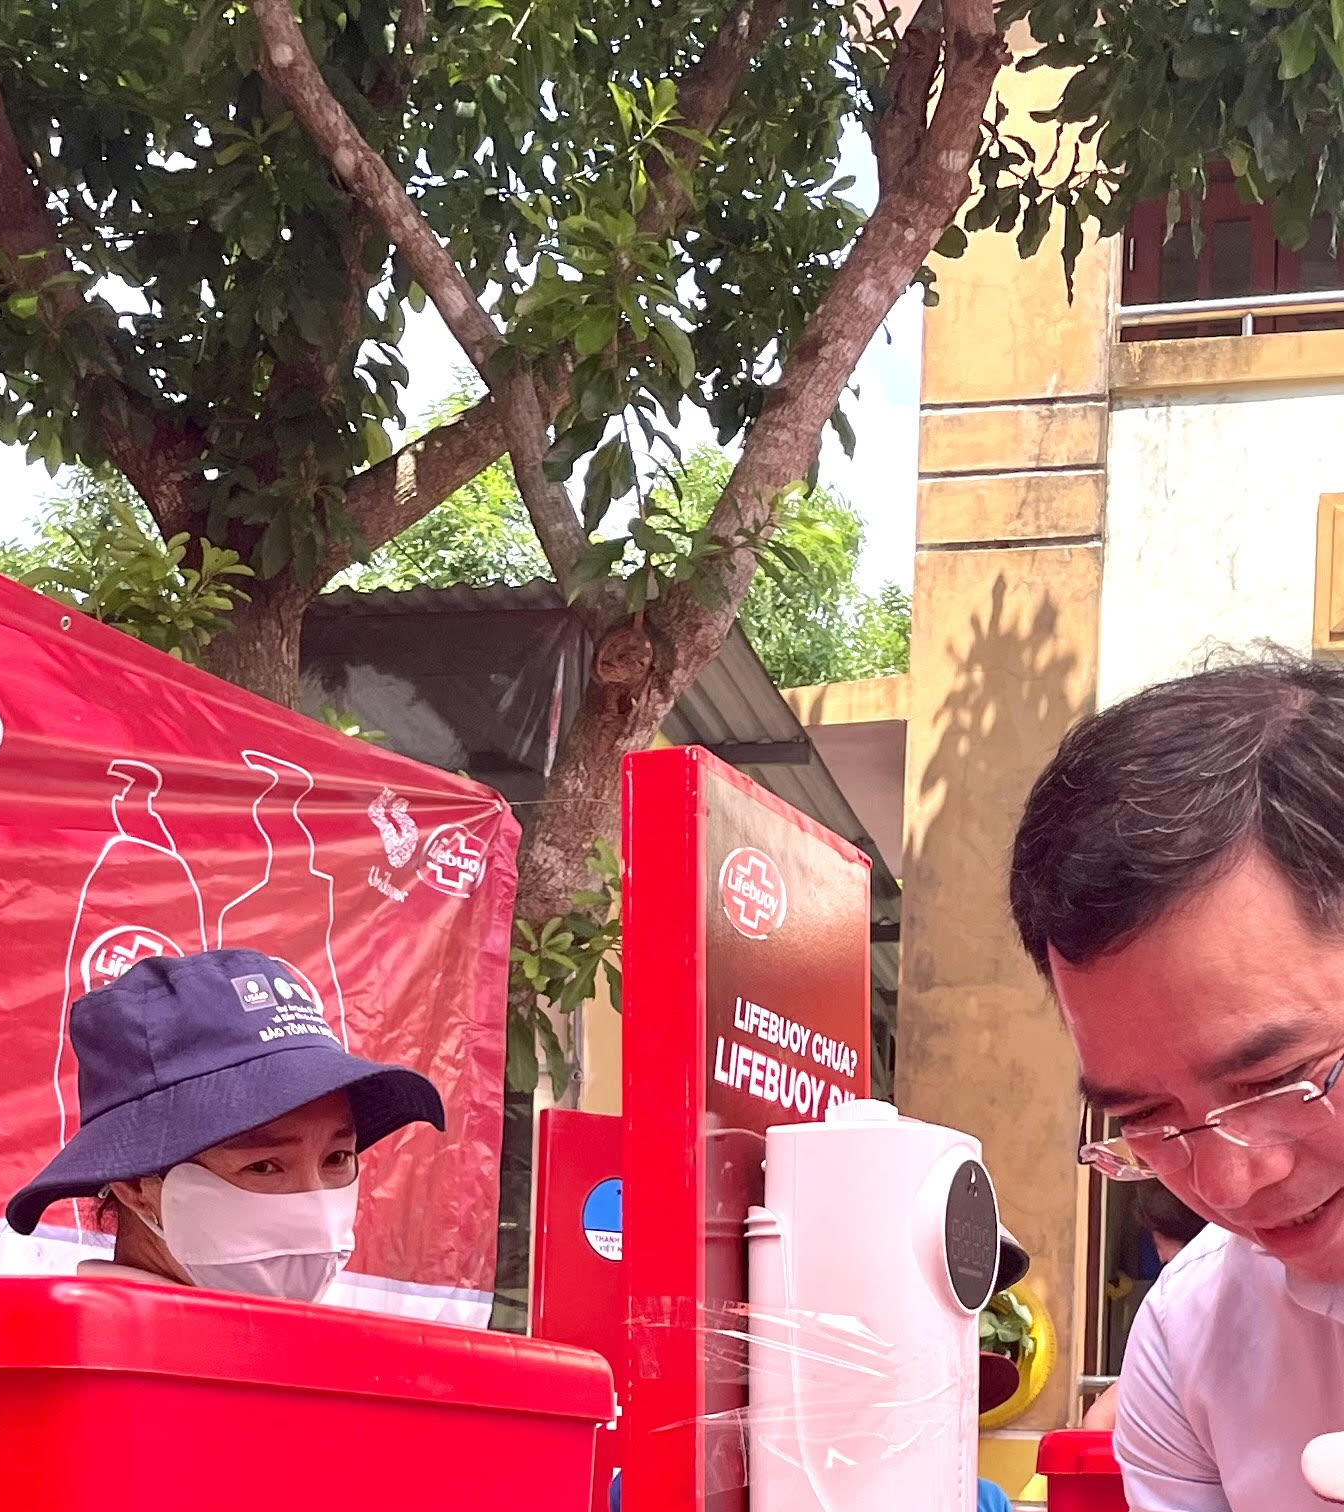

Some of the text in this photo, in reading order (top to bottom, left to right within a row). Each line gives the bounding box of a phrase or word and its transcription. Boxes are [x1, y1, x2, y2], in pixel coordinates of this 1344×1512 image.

[727, 866, 779, 917] Lifebuoy
[713, 1035, 826, 1119] LIFEBUOY
[733, 996, 858, 1078] LIFEBUOY CHƯA?
